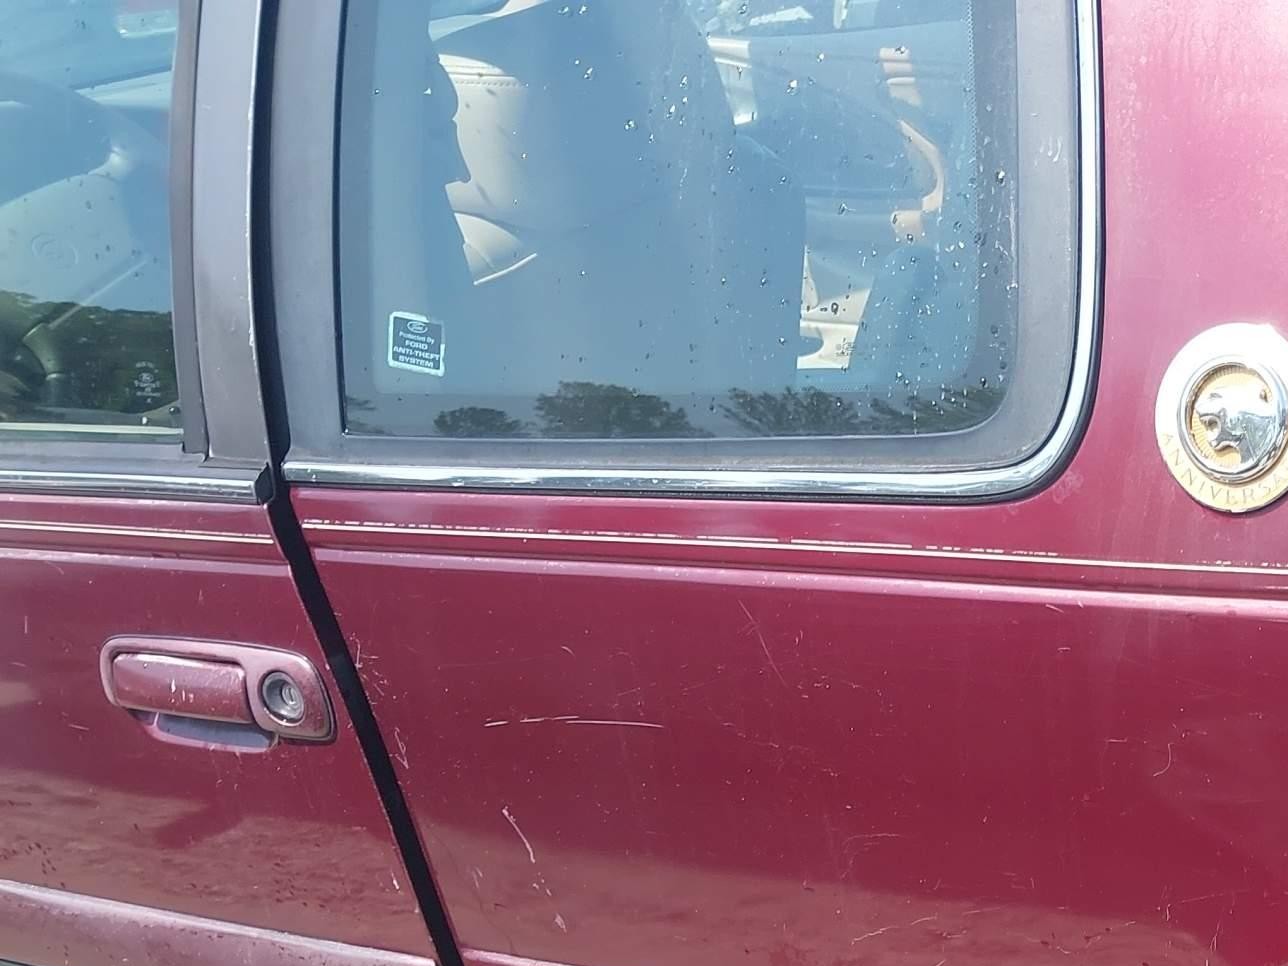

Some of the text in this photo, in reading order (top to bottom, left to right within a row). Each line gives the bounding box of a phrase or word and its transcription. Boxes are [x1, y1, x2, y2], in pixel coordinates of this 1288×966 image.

[405, 340, 428, 350] FORD
[393, 346, 441, 361] ANTI-THEFT
[399, 355, 434, 368] SYSTEM
